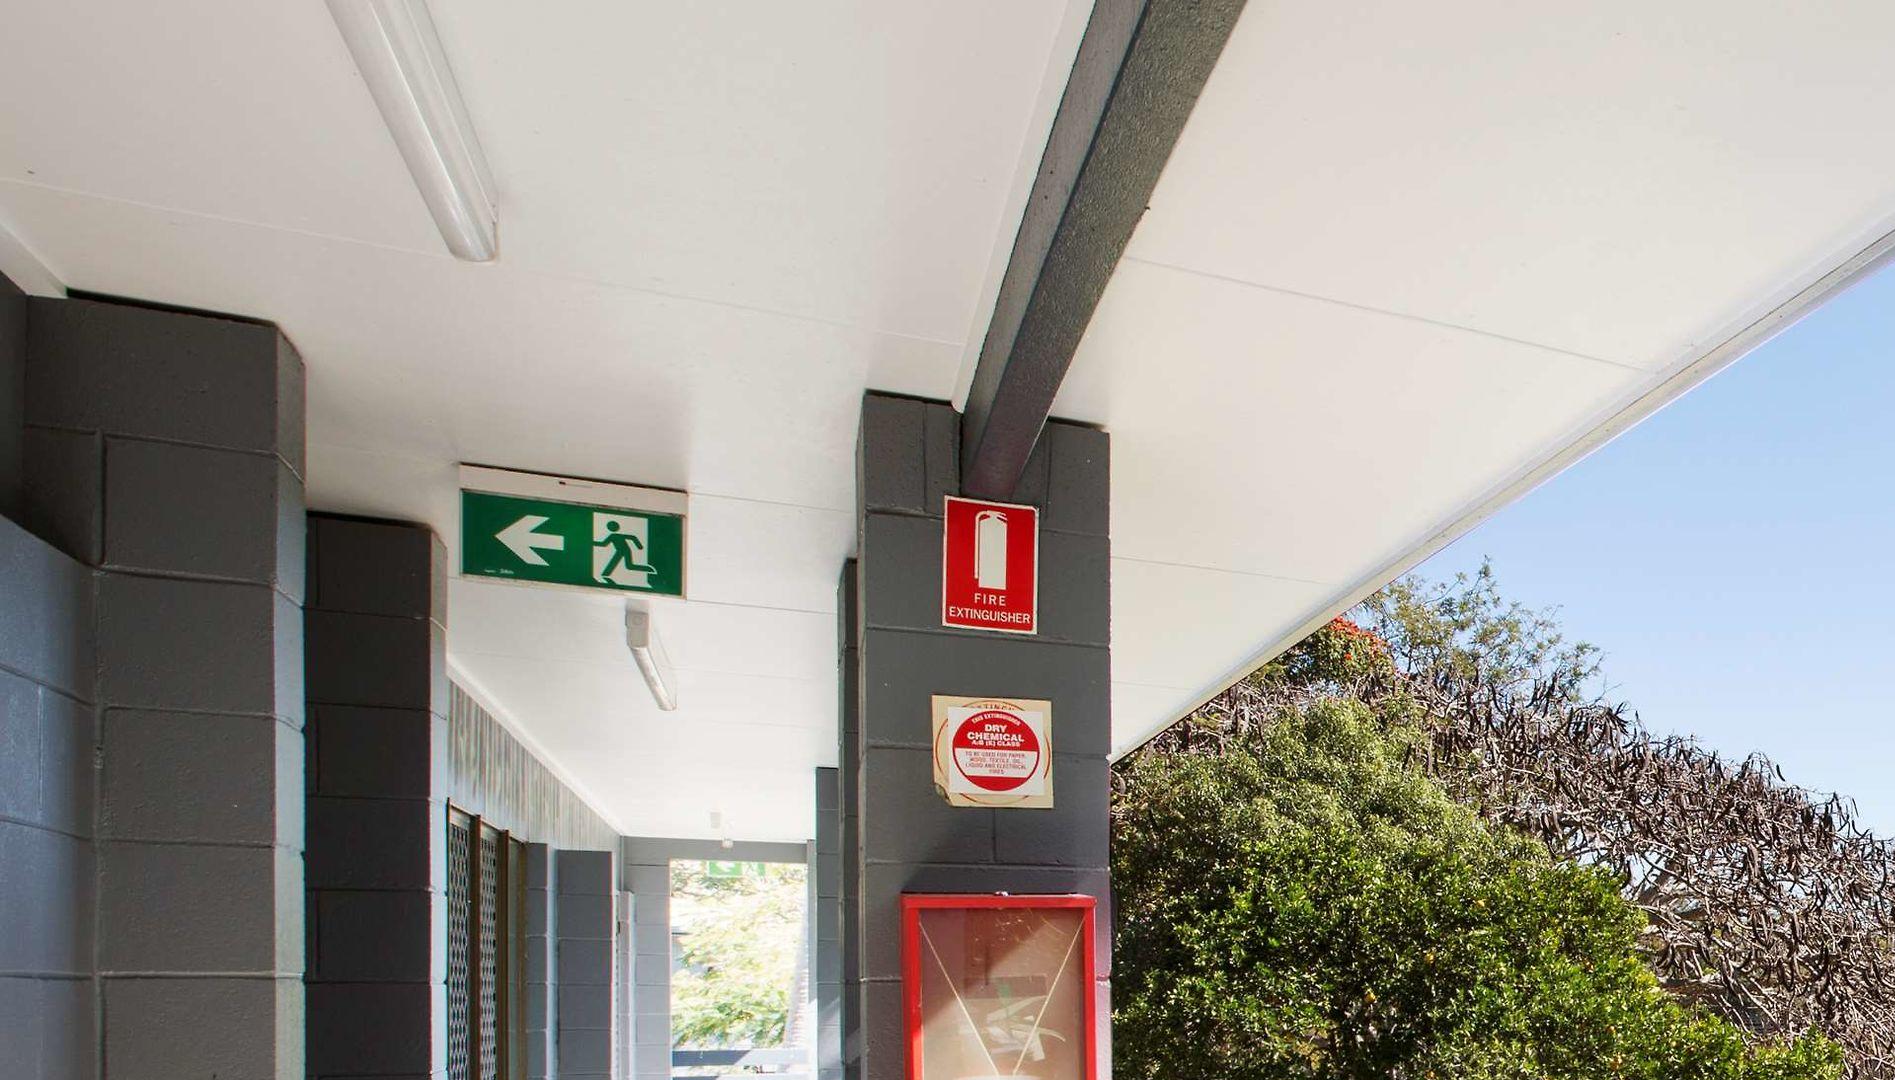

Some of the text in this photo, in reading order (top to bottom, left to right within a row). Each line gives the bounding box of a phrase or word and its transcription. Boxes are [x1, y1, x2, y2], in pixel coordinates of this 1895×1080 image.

[974, 592, 1006, 606] FIRE
[949, 606, 1031, 624] EXTINGUISHER
[984, 724, 1007, 733] DRY
[967, 731, 1025, 743] CHEMICAL
